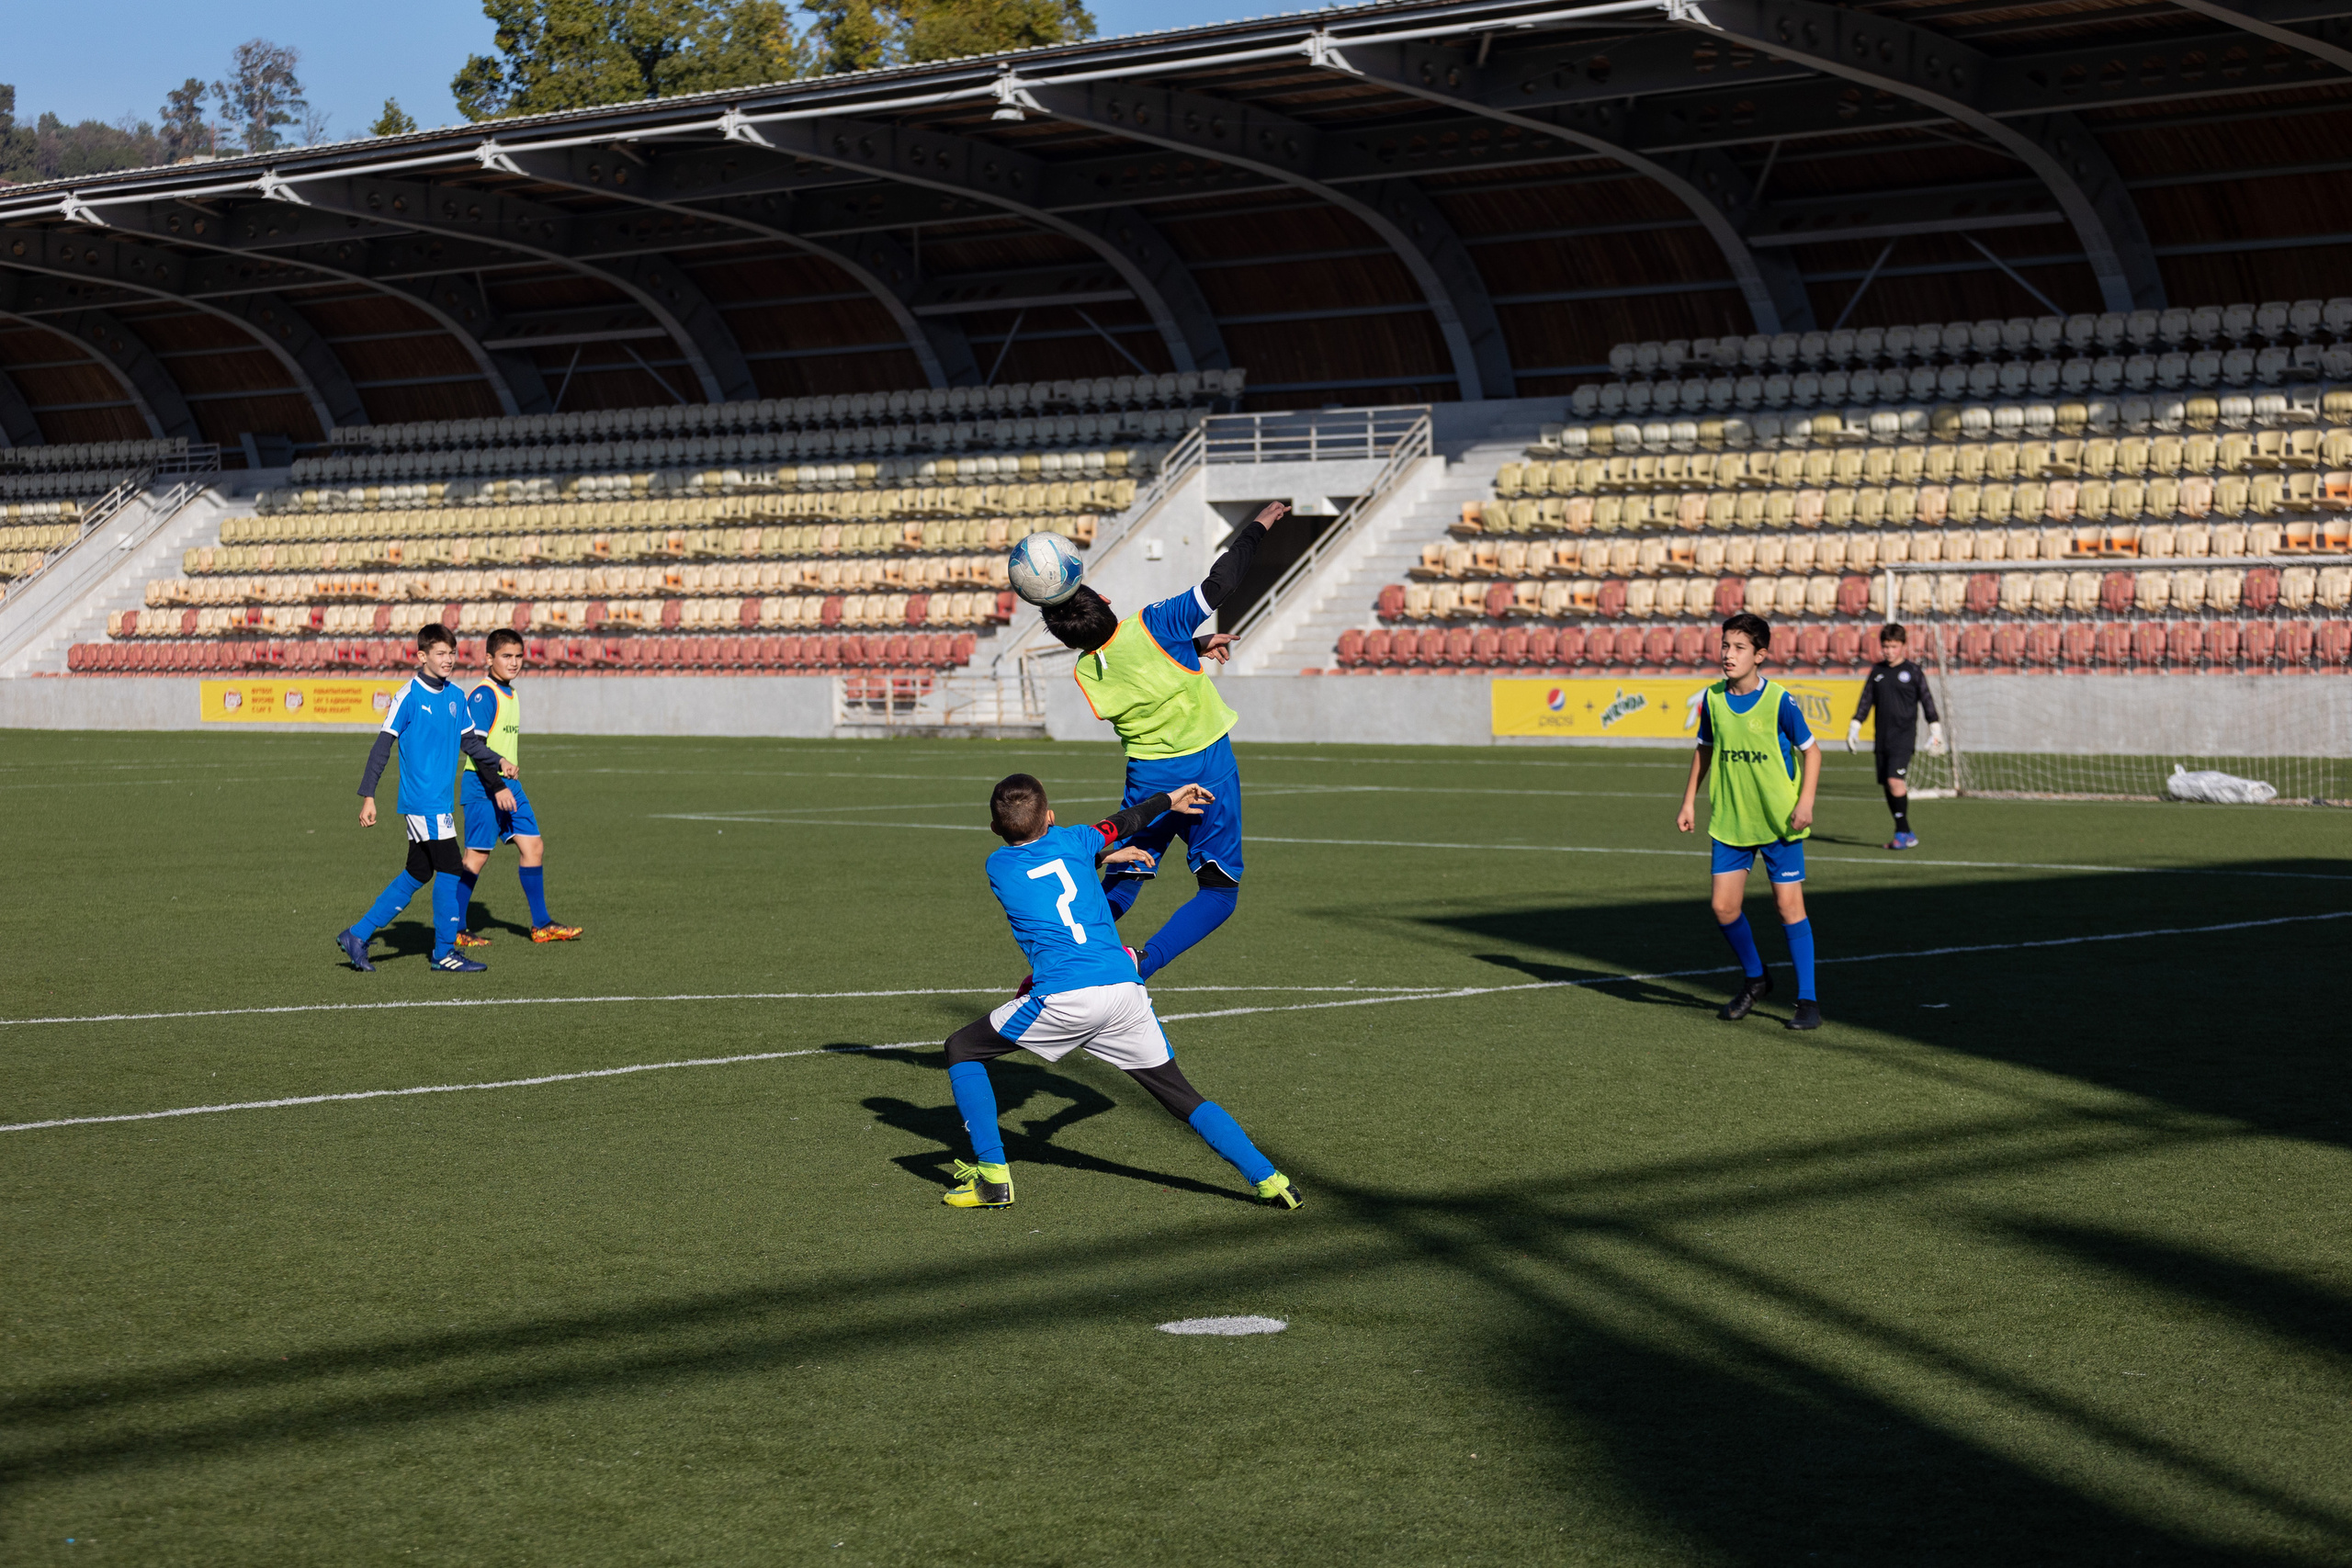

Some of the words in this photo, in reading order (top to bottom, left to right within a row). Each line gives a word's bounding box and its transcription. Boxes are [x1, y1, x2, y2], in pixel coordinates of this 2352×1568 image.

[1538, 714, 1574, 728] pepsi
[1096, 822, 1114, 835] C
[1026, 858, 1087, 944] 7
